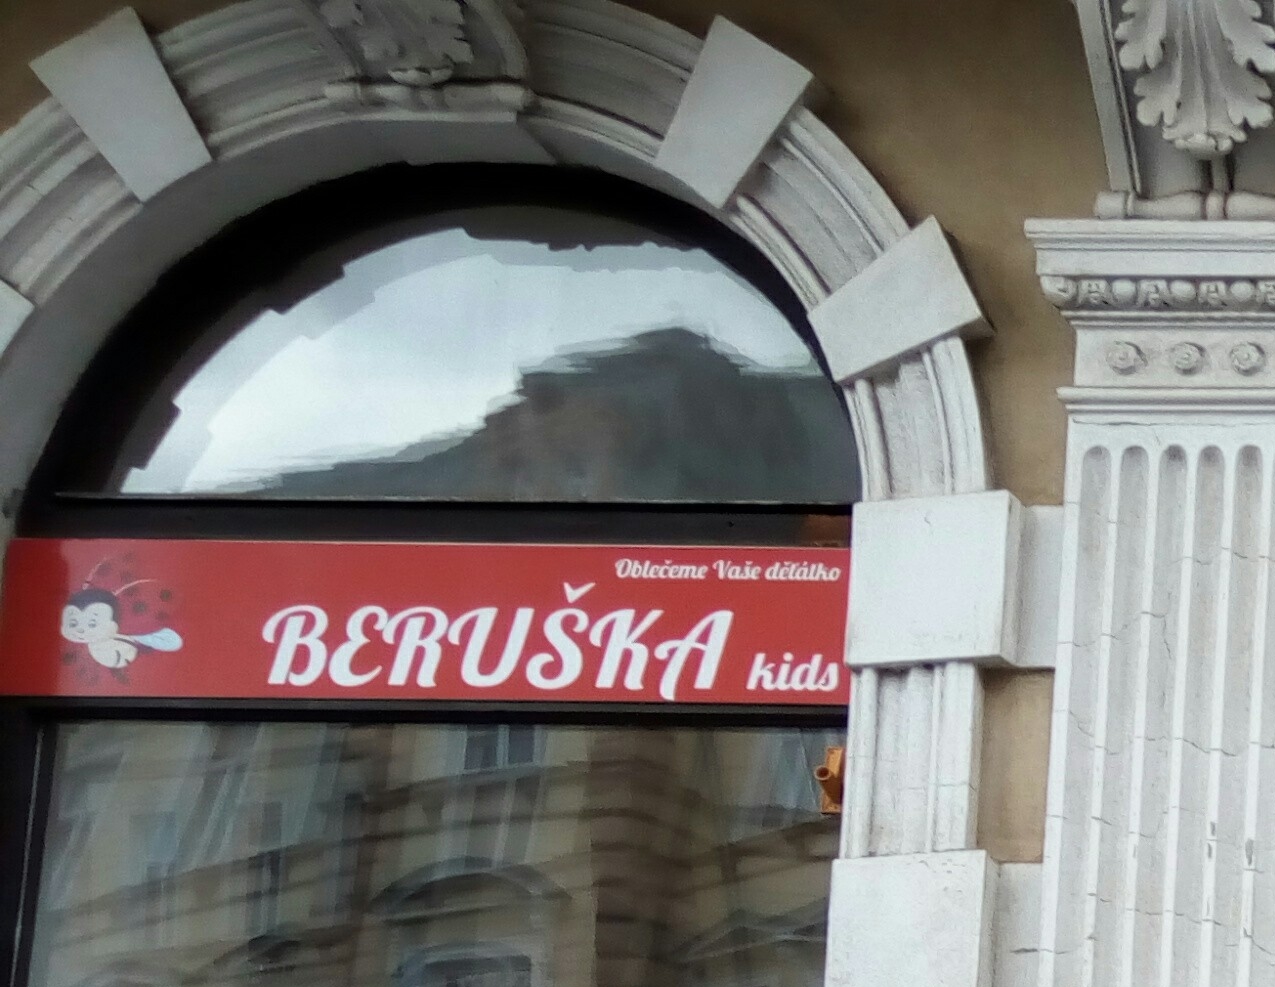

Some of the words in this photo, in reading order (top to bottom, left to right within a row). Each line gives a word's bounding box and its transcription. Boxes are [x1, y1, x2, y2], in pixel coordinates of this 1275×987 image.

[614, 558, 708, 580] Oblečeme
[712, 559, 761, 580] Vaše
[262, 581, 734, 701] BERUŠKA
[746, 651, 840, 692] kids
